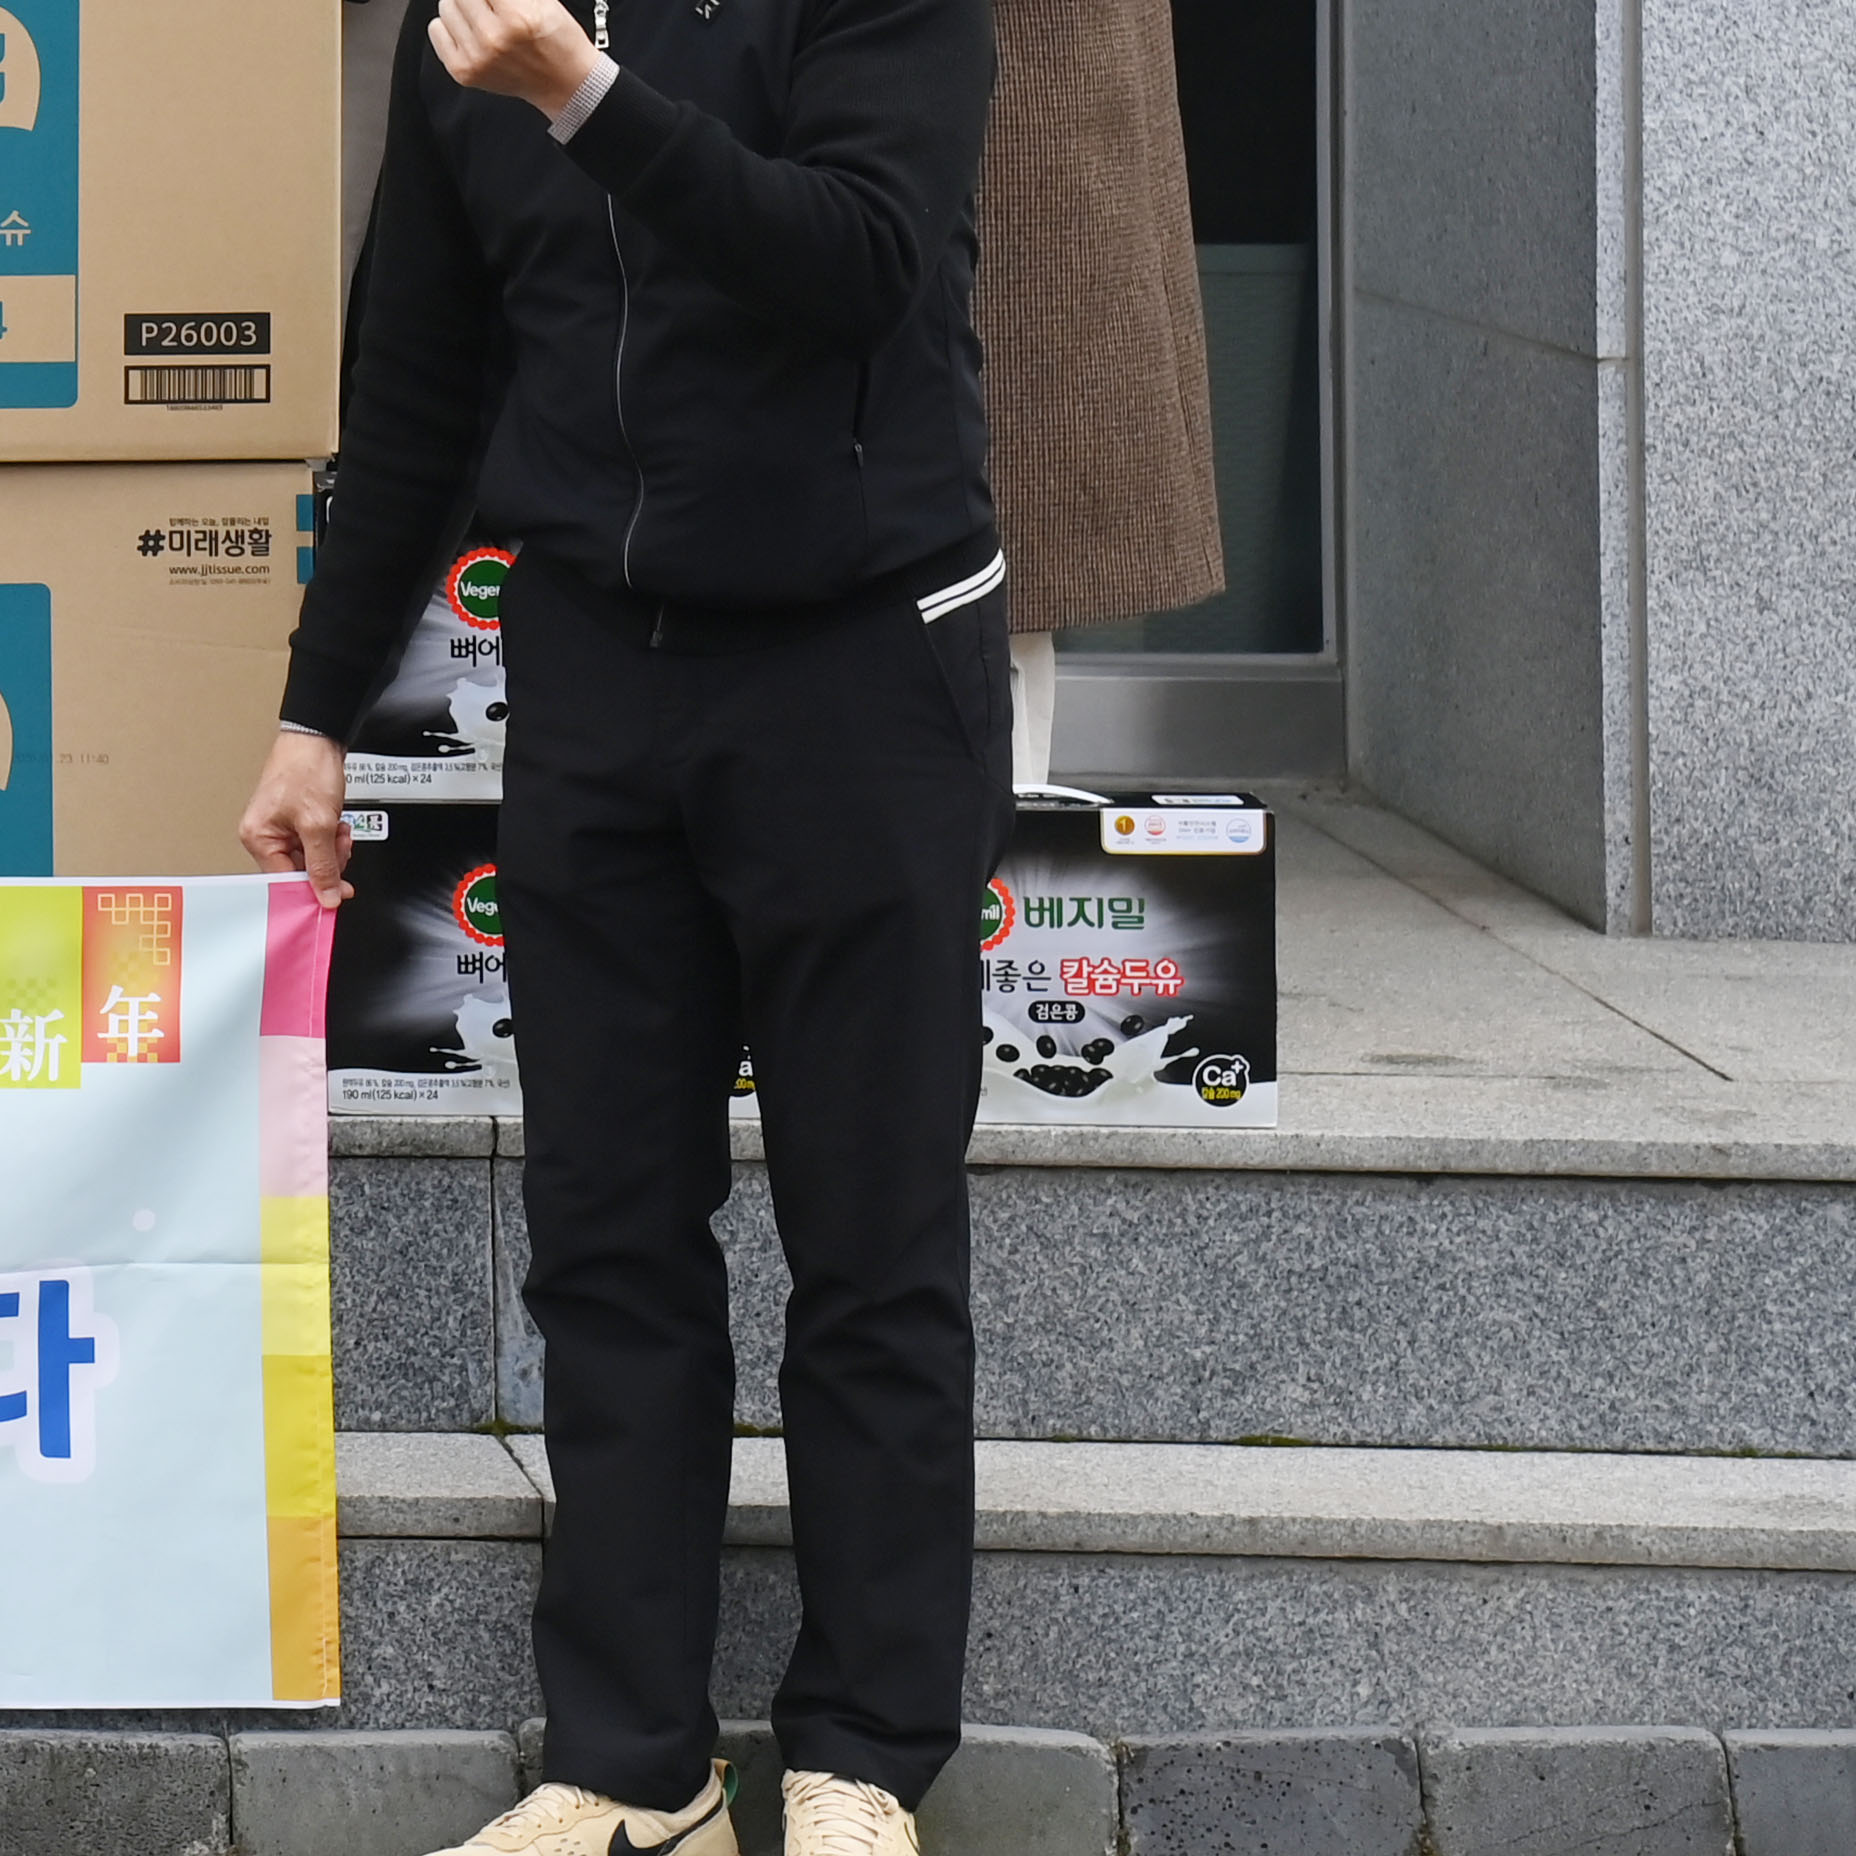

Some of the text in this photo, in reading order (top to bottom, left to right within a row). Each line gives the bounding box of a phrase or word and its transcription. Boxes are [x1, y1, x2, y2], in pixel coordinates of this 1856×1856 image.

[141, 321, 257, 347] P26003
[137, 528, 272, 557] #미래생활
[169, 564, 270, 576] www.jjtissue.com
[1024, 896, 1145, 930] 베지밀
[980, 956, 1184, 997] 좋은 칼슘두유
[1036, 1004, 1079, 1021] 검은콩
